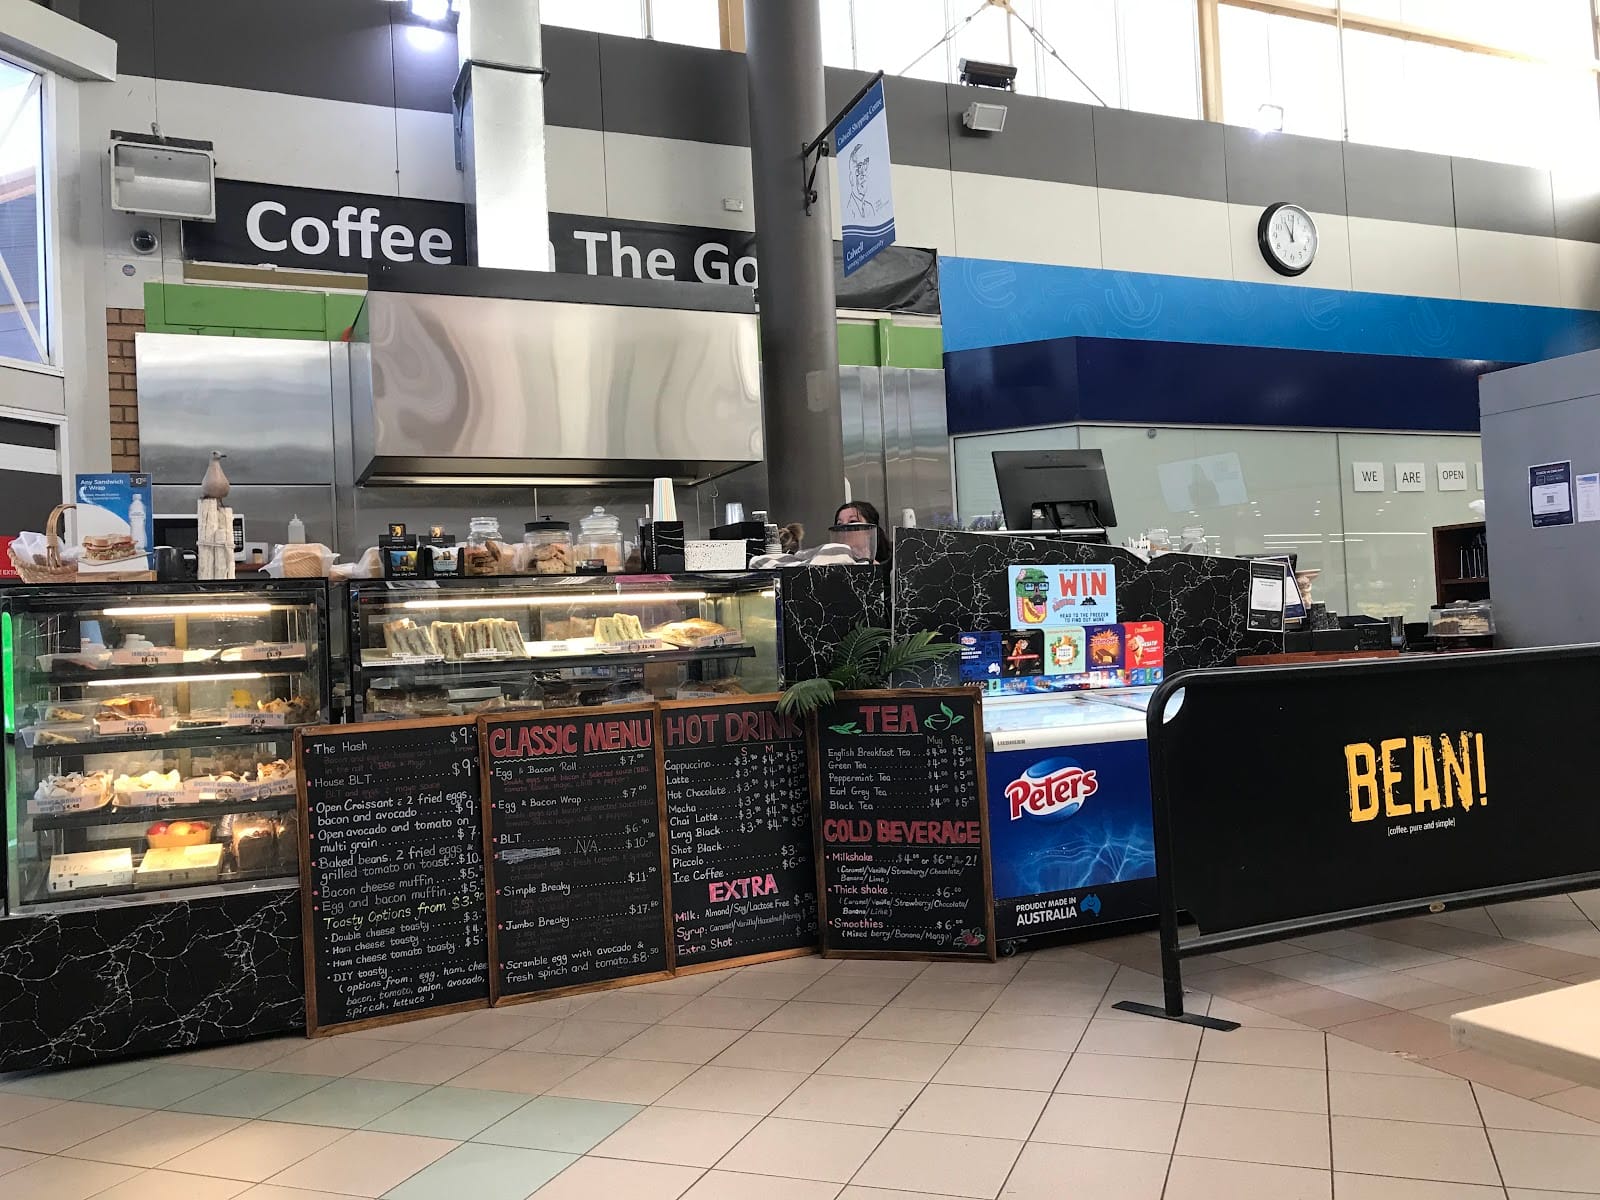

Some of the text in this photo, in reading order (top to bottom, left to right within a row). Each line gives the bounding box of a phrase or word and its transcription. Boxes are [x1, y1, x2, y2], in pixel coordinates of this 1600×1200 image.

[246, 201, 453, 265] Coffee
[573, 230, 759, 288] The Go
[80, 479, 93, 487] Any
[1362, 471, 1378, 482] WE
[1402, 471, 1422, 483] ARE
[1442, 470, 1465, 480] OPEN
[1059, 572, 1107, 597] WIN
[859, 704, 919, 733] TEA
[489, 719, 651, 757] CLASSIC MENU
[666, 714, 720, 746] HOT
[313, 740, 368, 755] The Hash
[926, 734, 964, 749] Mug Pot
[741, 743, 797, 757] S M L
[827, 747, 911, 761] English Breakfast Tea
[496, 761, 577, 781] Egg Bacon Roll
[664, 760, 711, 774] Cappuccino
[828, 761, 867, 770] Green Tea
[315, 774, 373, 789] House BLT
[666, 775, 690, 785] Latte
[828, 772, 891, 786] Peppermint Tea
[1344, 730, 1488, 822] BEAN!
[667, 785, 727, 800] Hot Chocolate
[829, 786, 887, 800] Earl Grey Tea
[1006, 769, 1098, 818] Peters
[316, 791, 443, 818] Open Croissant 2 fried
[498, 795, 582, 814] Egg Bacon Wrap
[668, 804, 697, 813] Mocha
[829, 800, 874, 810] Black Tea
[317, 808, 418, 826] bacon and avocado
[670, 813, 719, 826] Chai Latte
[318, 816, 469, 846] Open avocado and tomato on
[670, 826, 721, 843] Long Black
[823, 818, 981, 844] COLD BEVERAGE
[1409, 824, 1423, 834] pure
[1423, 820, 1435, 830] and
[320, 838, 378, 855] multi grain
[500, 833, 522, 844] BLT
[576, 839, 599, 855] N/A
[671, 842, 723, 855] Shot Black
[318, 844, 463, 869] Baked fried eggs
[672, 856, 704, 869] Piccolo
[832, 851, 874, 862] Milkshake
[320, 856, 449, 886] grilled tomato on toast
[673, 867, 725, 883] Ice Coffee
[321, 875, 434, 899] Bacon cheese muffin
[503, 881, 571, 898] Simple Breaky
[708, 873, 779, 903] EXTRA
[833, 885, 888, 895] Thick shake
[322, 887, 447, 915] Egg and bacon muffin
[775, 898, 790, 908] Free
[1016, 901, 1047, 912] PROUDLY
[1048, 898, 1067, 908] MADE
[323, 901, 447, 930] Toasty Options from
[505, 915, 570, 931] Jumbo Breaky
[834, 918, 884, 928] Smoothies
[1016, 906, 1077, 927] AUSTRALIA
[330, 921, 430, 943] Double cheese toasty
[332, 935, 419, 955] Ham cheese toasty
[678, 938, 733, 956] Extra Shot
[332, 940, 456, 968] Ham cheese tomato toasty
[505, 941, 632, 970] Scramble egg with avocado
[333, 967, 388, 983] DIY toasty
[505, 970, 534, 985] fresh
[571, 962, 589, 973] and
[595, 956, 628, 968] tomato
